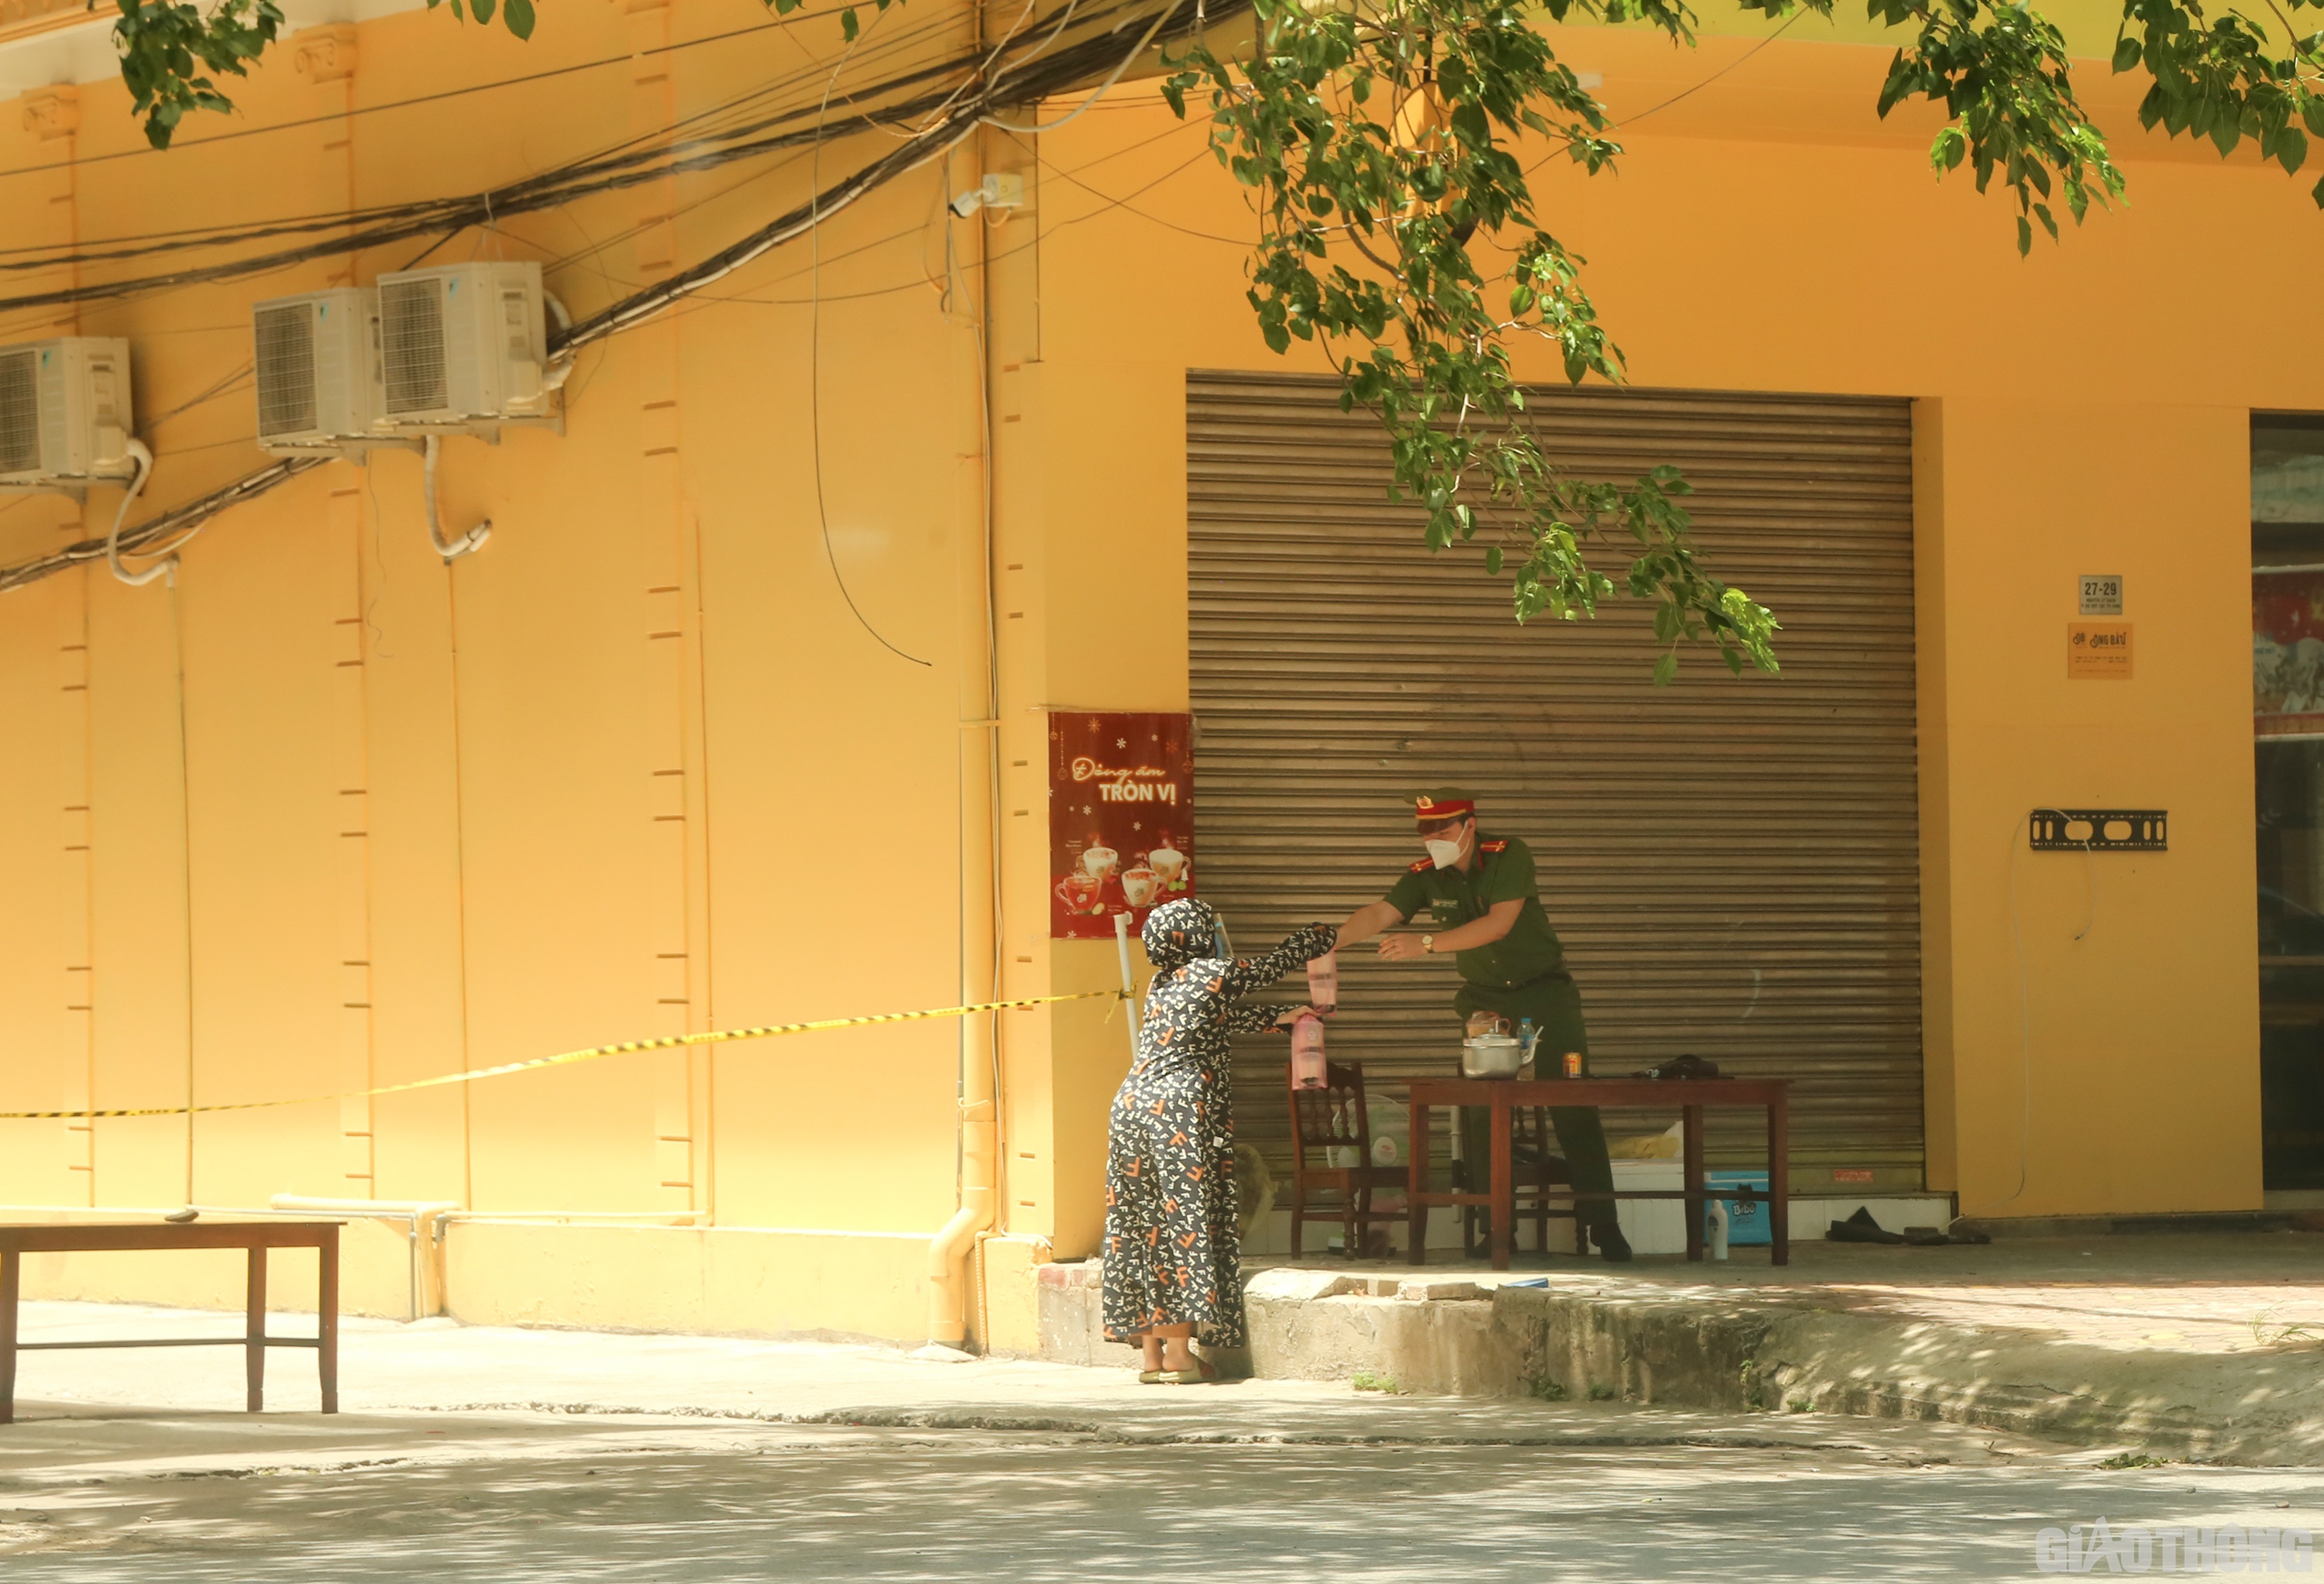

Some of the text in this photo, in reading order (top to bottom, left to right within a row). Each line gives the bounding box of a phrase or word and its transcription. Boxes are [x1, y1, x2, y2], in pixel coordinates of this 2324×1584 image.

[2085, 582, 2116, 596] 27-29
[1098, 779, 1176, 806] TRÒN VỊ
